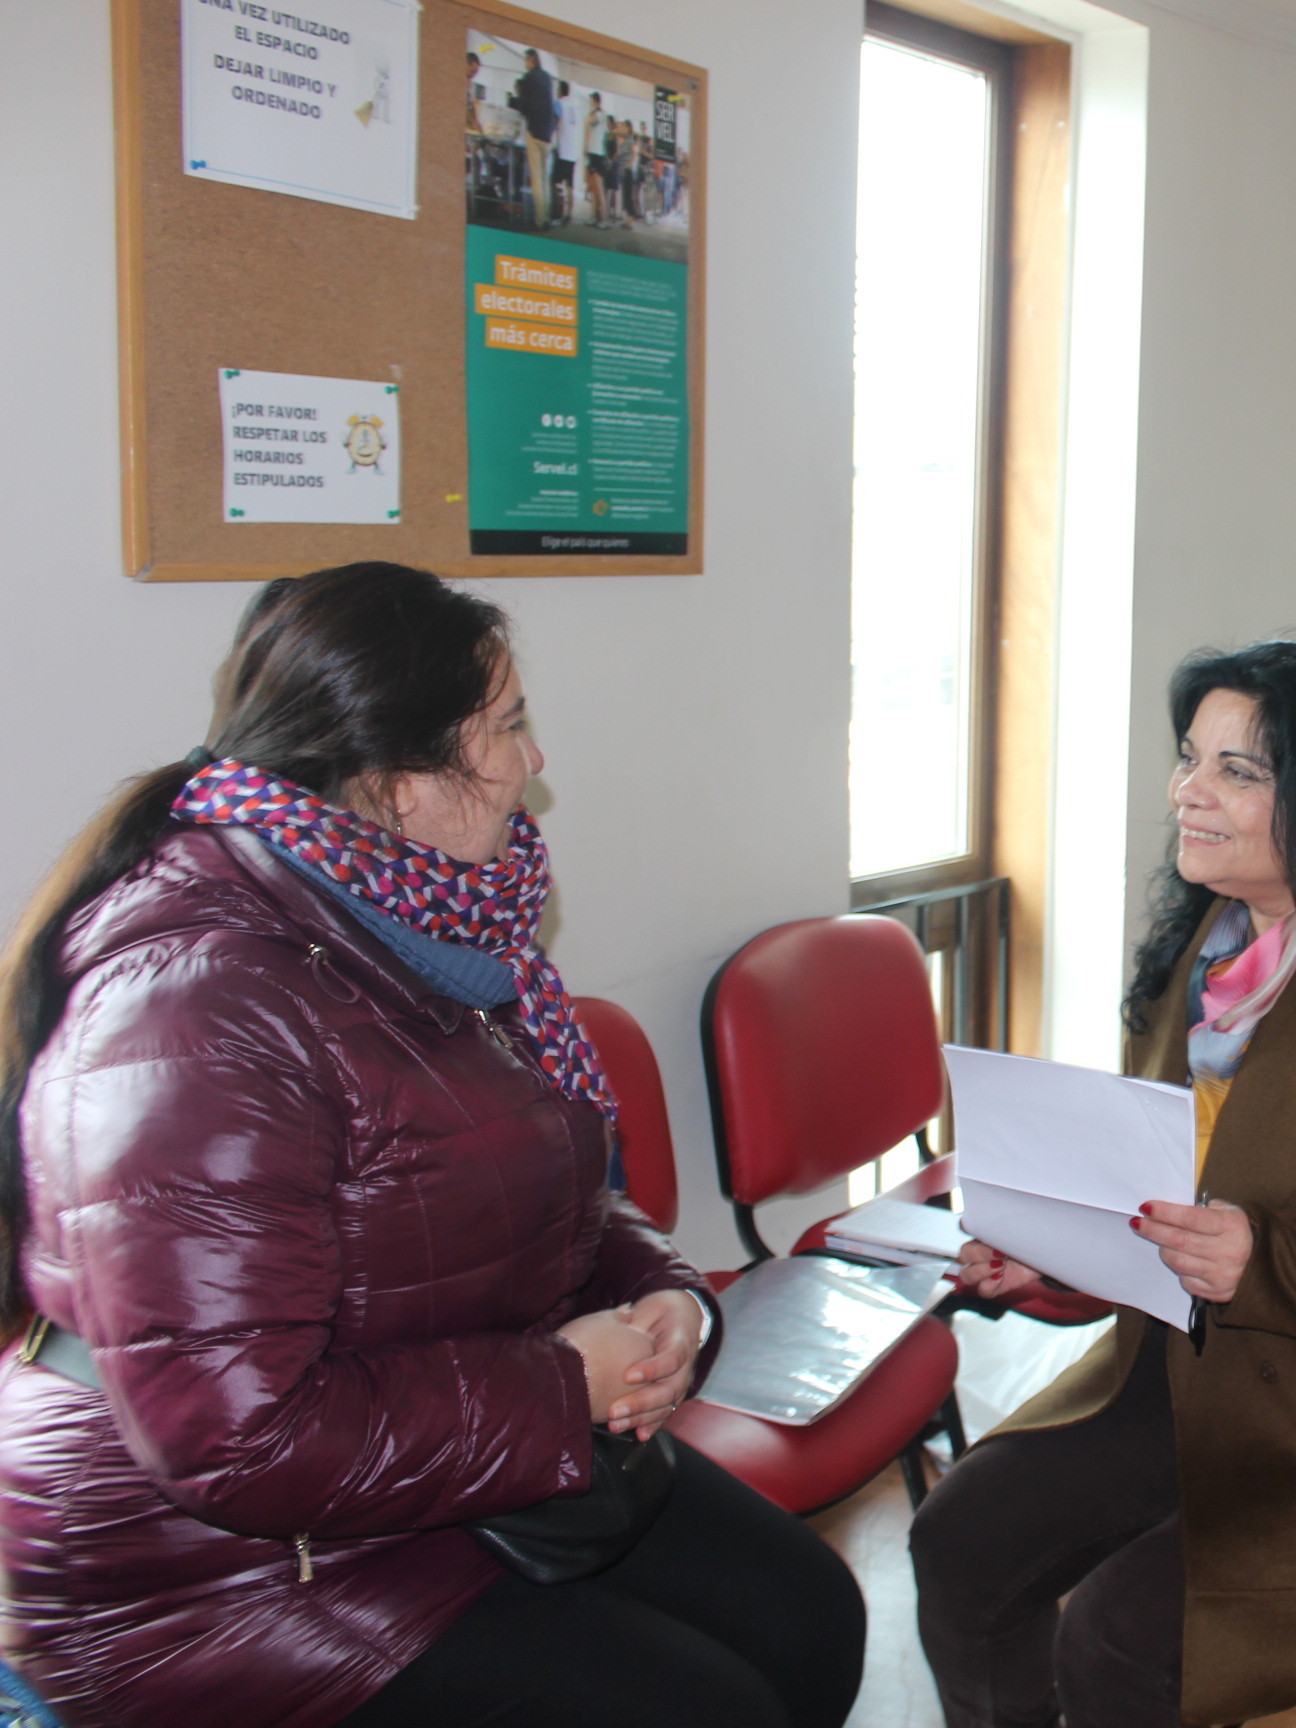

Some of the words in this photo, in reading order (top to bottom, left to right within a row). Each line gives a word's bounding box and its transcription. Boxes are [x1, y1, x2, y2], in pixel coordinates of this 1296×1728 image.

[238, 0, 268, 21] VEZ
[271, 10, 351, 45] UTILIZADO
[234, 25, 251, 42] EL
[255, 31, 319, 60] ESPACIO
[213, 54, 264, 79] DEJAR
[269, 68, 322, 94] LIMPIO
[327, 83, 336, 98] Y
[231, 85, 321, 119] ORDENADO
[655, 100, 675, 122] SER
[655, 120, 675, 143] VEL
[500, 261, 574, 290] Trámites
[481, 291, 575, 320] electorales
[490, 324, 526, 345] más
[529, 332, 574, 351] cerca
[232, 403, 263, 418] ¡POR
[268, 405, 317, 420] FAVOR!
[233, 426, 298, 442] RESPETAR
[303, 431, 327, 443] LOS
[234, 450, 304, 465] HORARIOS
[234, 473, 324, 488] ESTIPULADOS
